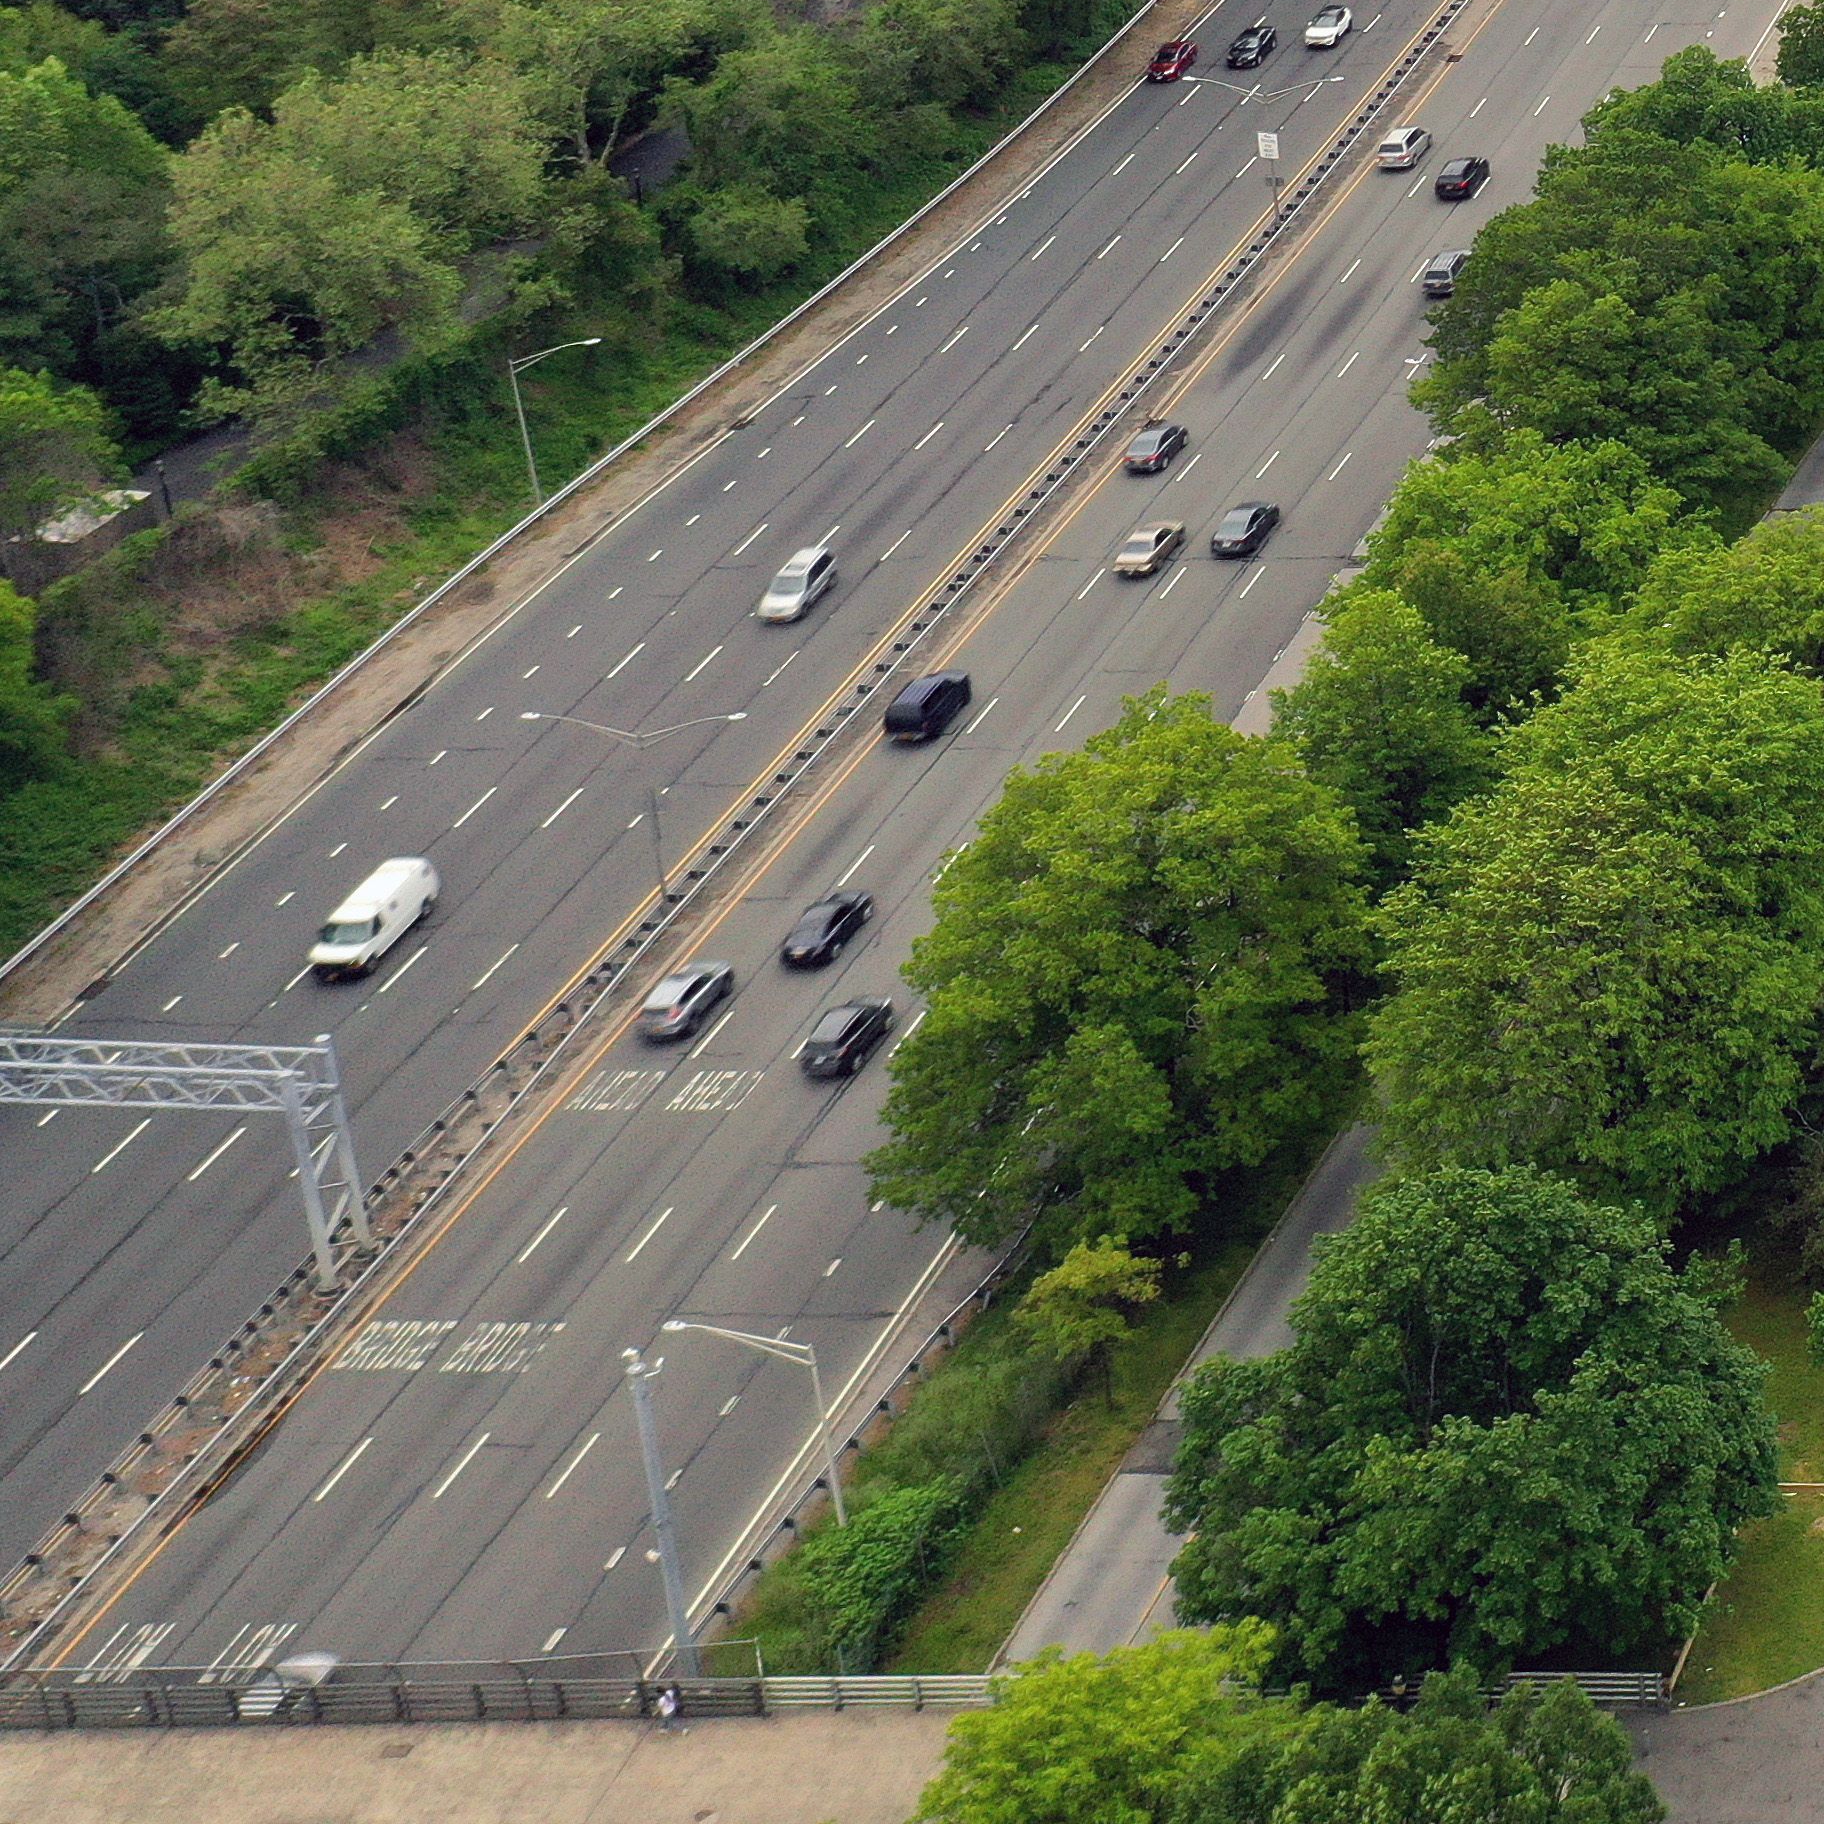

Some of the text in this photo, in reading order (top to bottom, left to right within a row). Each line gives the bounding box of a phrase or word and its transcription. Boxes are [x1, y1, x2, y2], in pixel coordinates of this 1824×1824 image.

[564, 1070, 668, 1111] AHEAD
[664, 1070, 766, 1111] AHEAD
[332, 1320, 459, 1371] BRIDGE
[439, 1321, 567, 1373] BRIDGE
